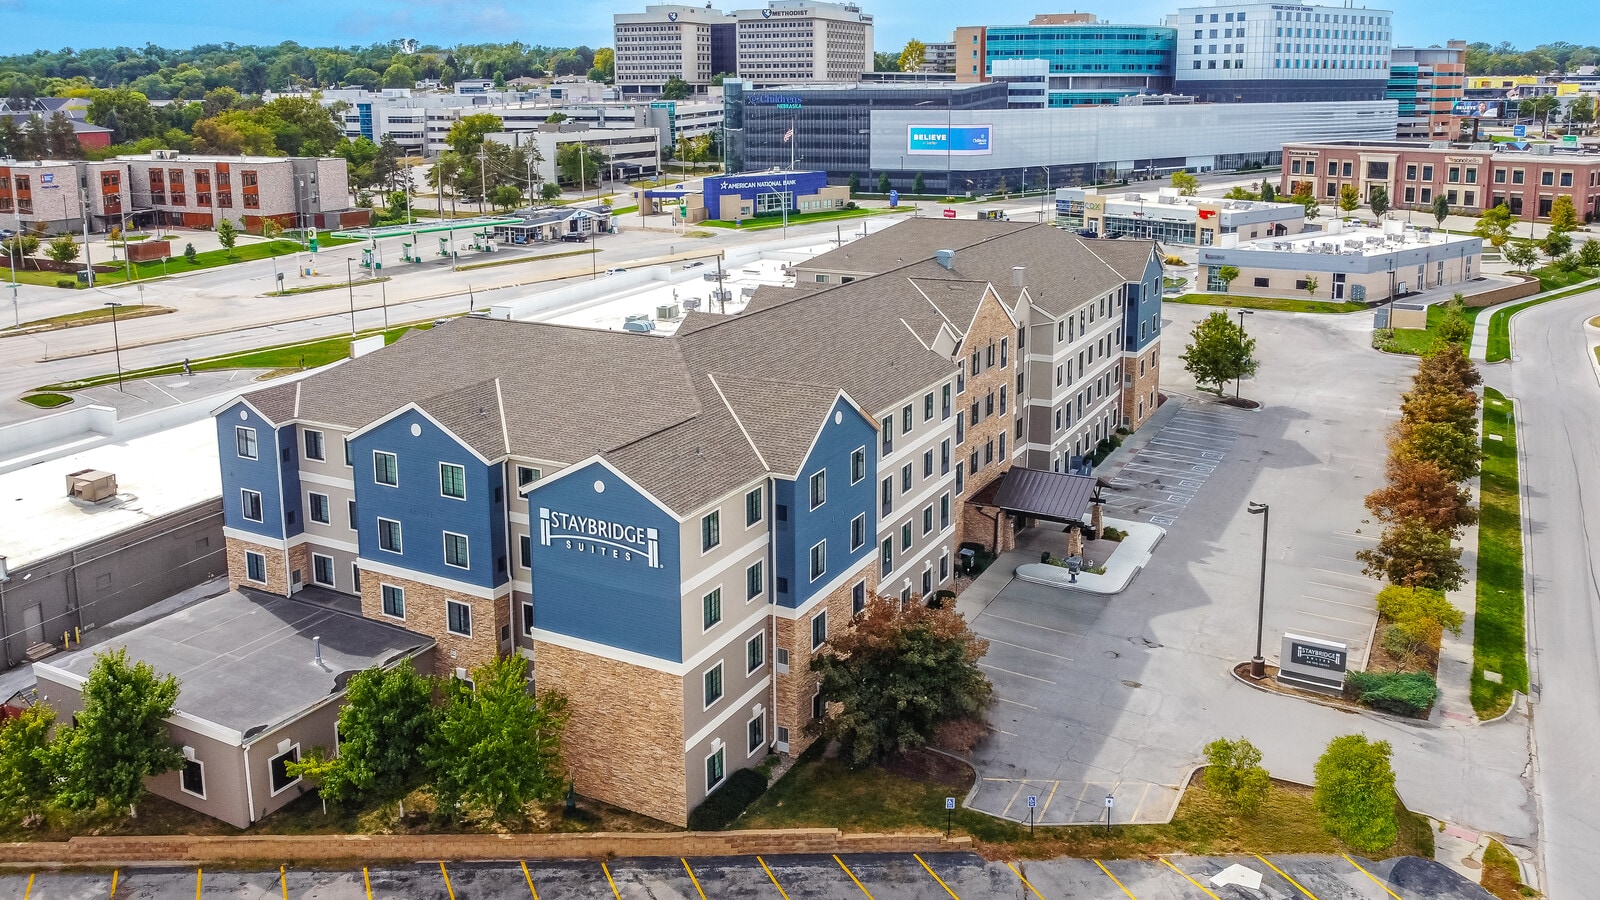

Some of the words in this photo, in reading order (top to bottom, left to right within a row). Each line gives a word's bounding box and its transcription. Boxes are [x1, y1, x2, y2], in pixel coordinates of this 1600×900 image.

[760, 93, 802, 104] Children's
[1084, 202, 1102, 211] COX
[551, 511, 646, 545] STAYBRIDGE
[566, 540, 632, 561] SUITES
[1302, 648, 1336, 659] STAYBRIDGE
